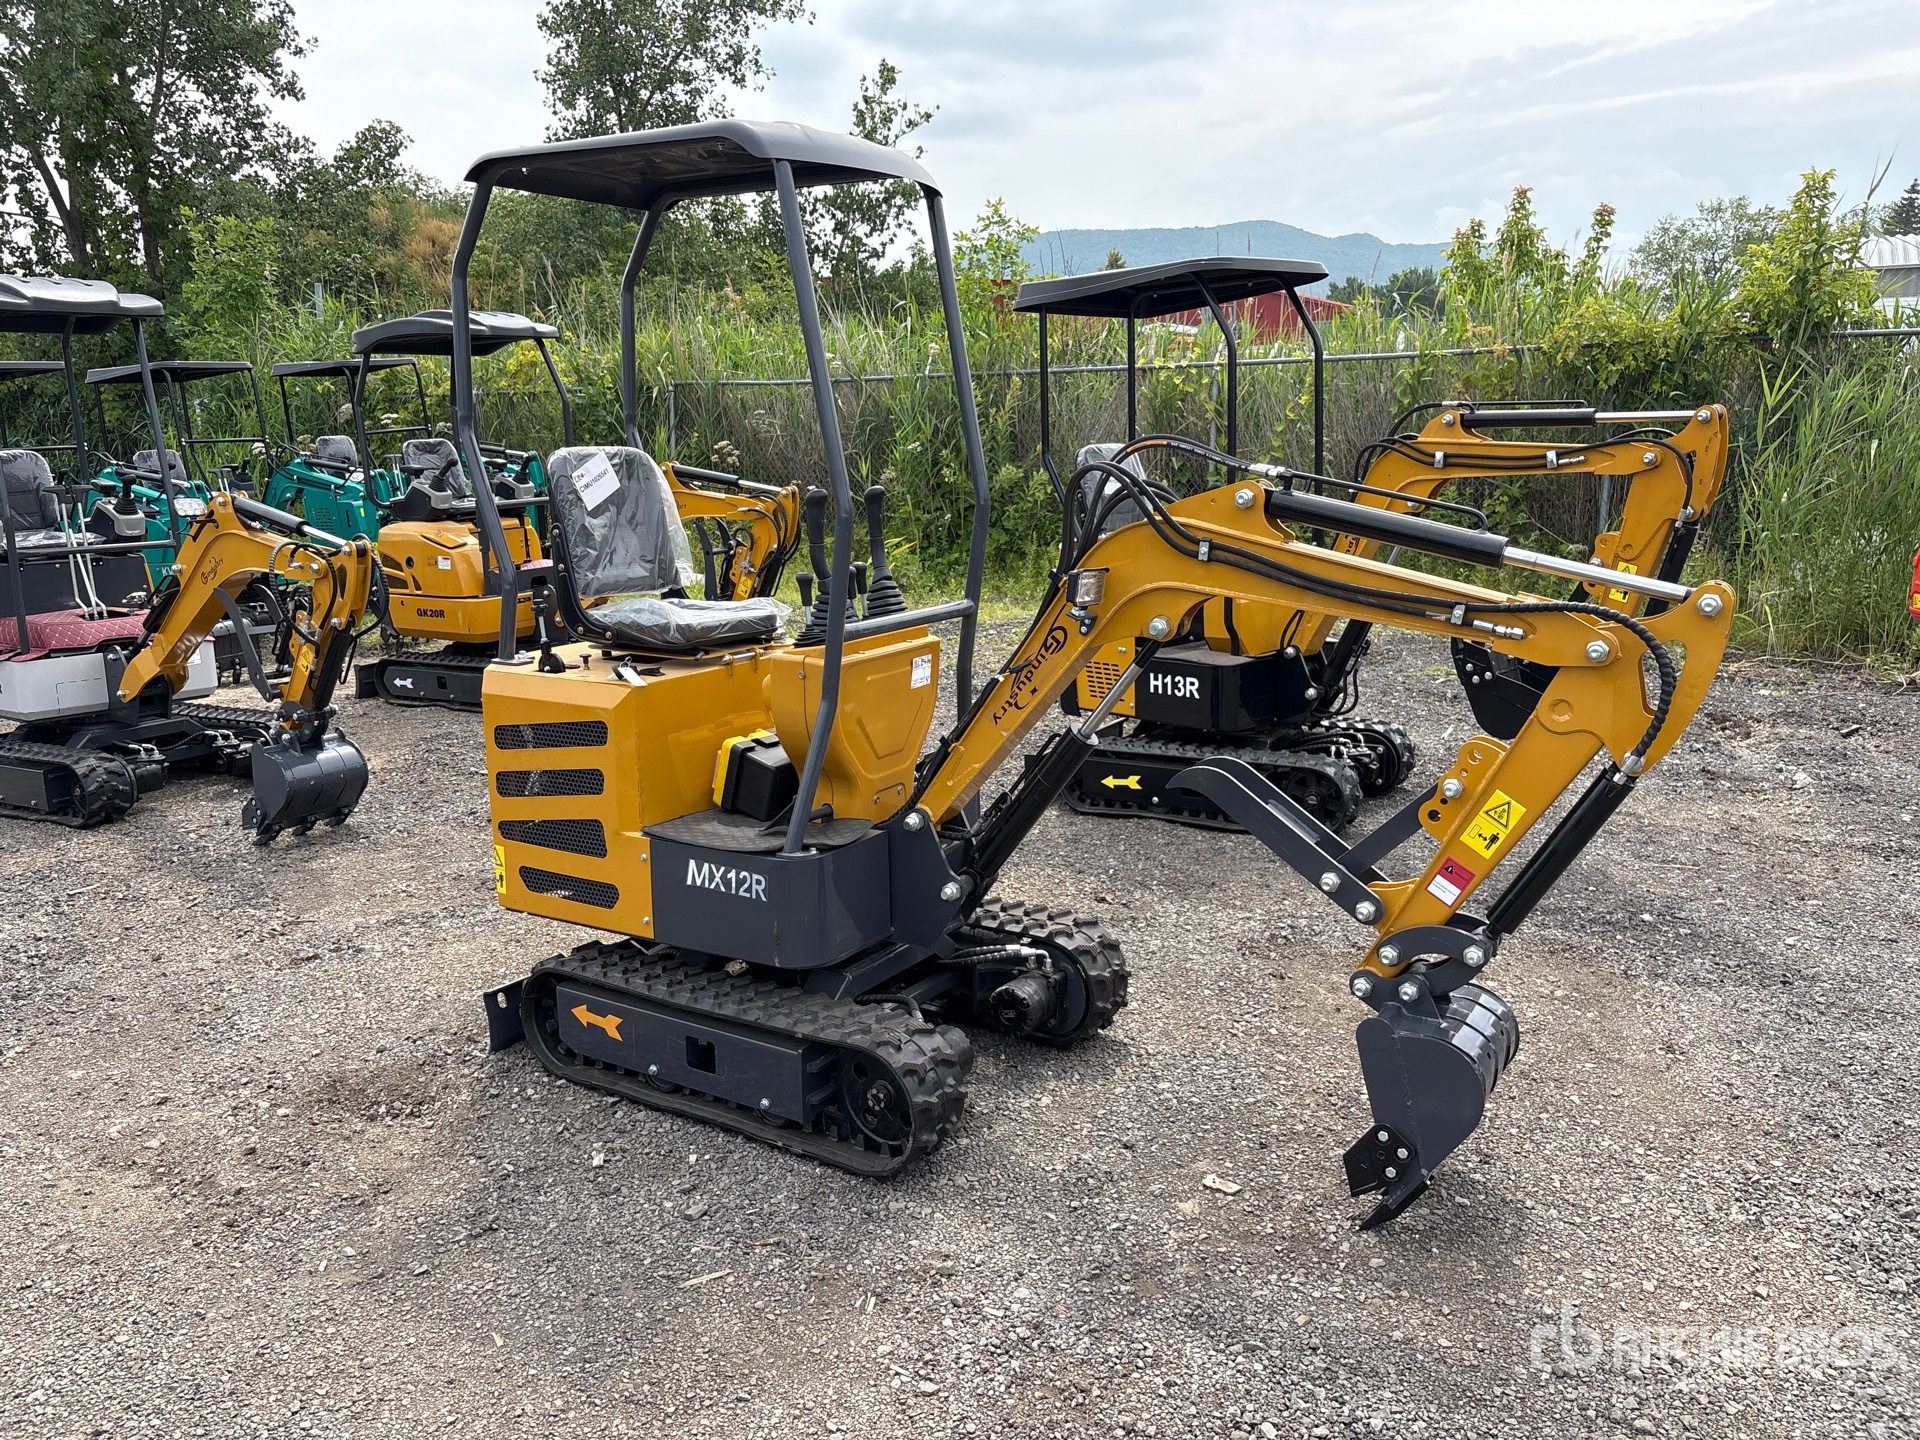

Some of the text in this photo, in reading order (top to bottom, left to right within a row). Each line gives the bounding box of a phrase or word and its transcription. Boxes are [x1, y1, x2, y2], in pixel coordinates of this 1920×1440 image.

[416, 607, 446, 619] QK20R
[1149, 672, 1200, 699] H13R
[686, 859, 768, 902] MX12R
